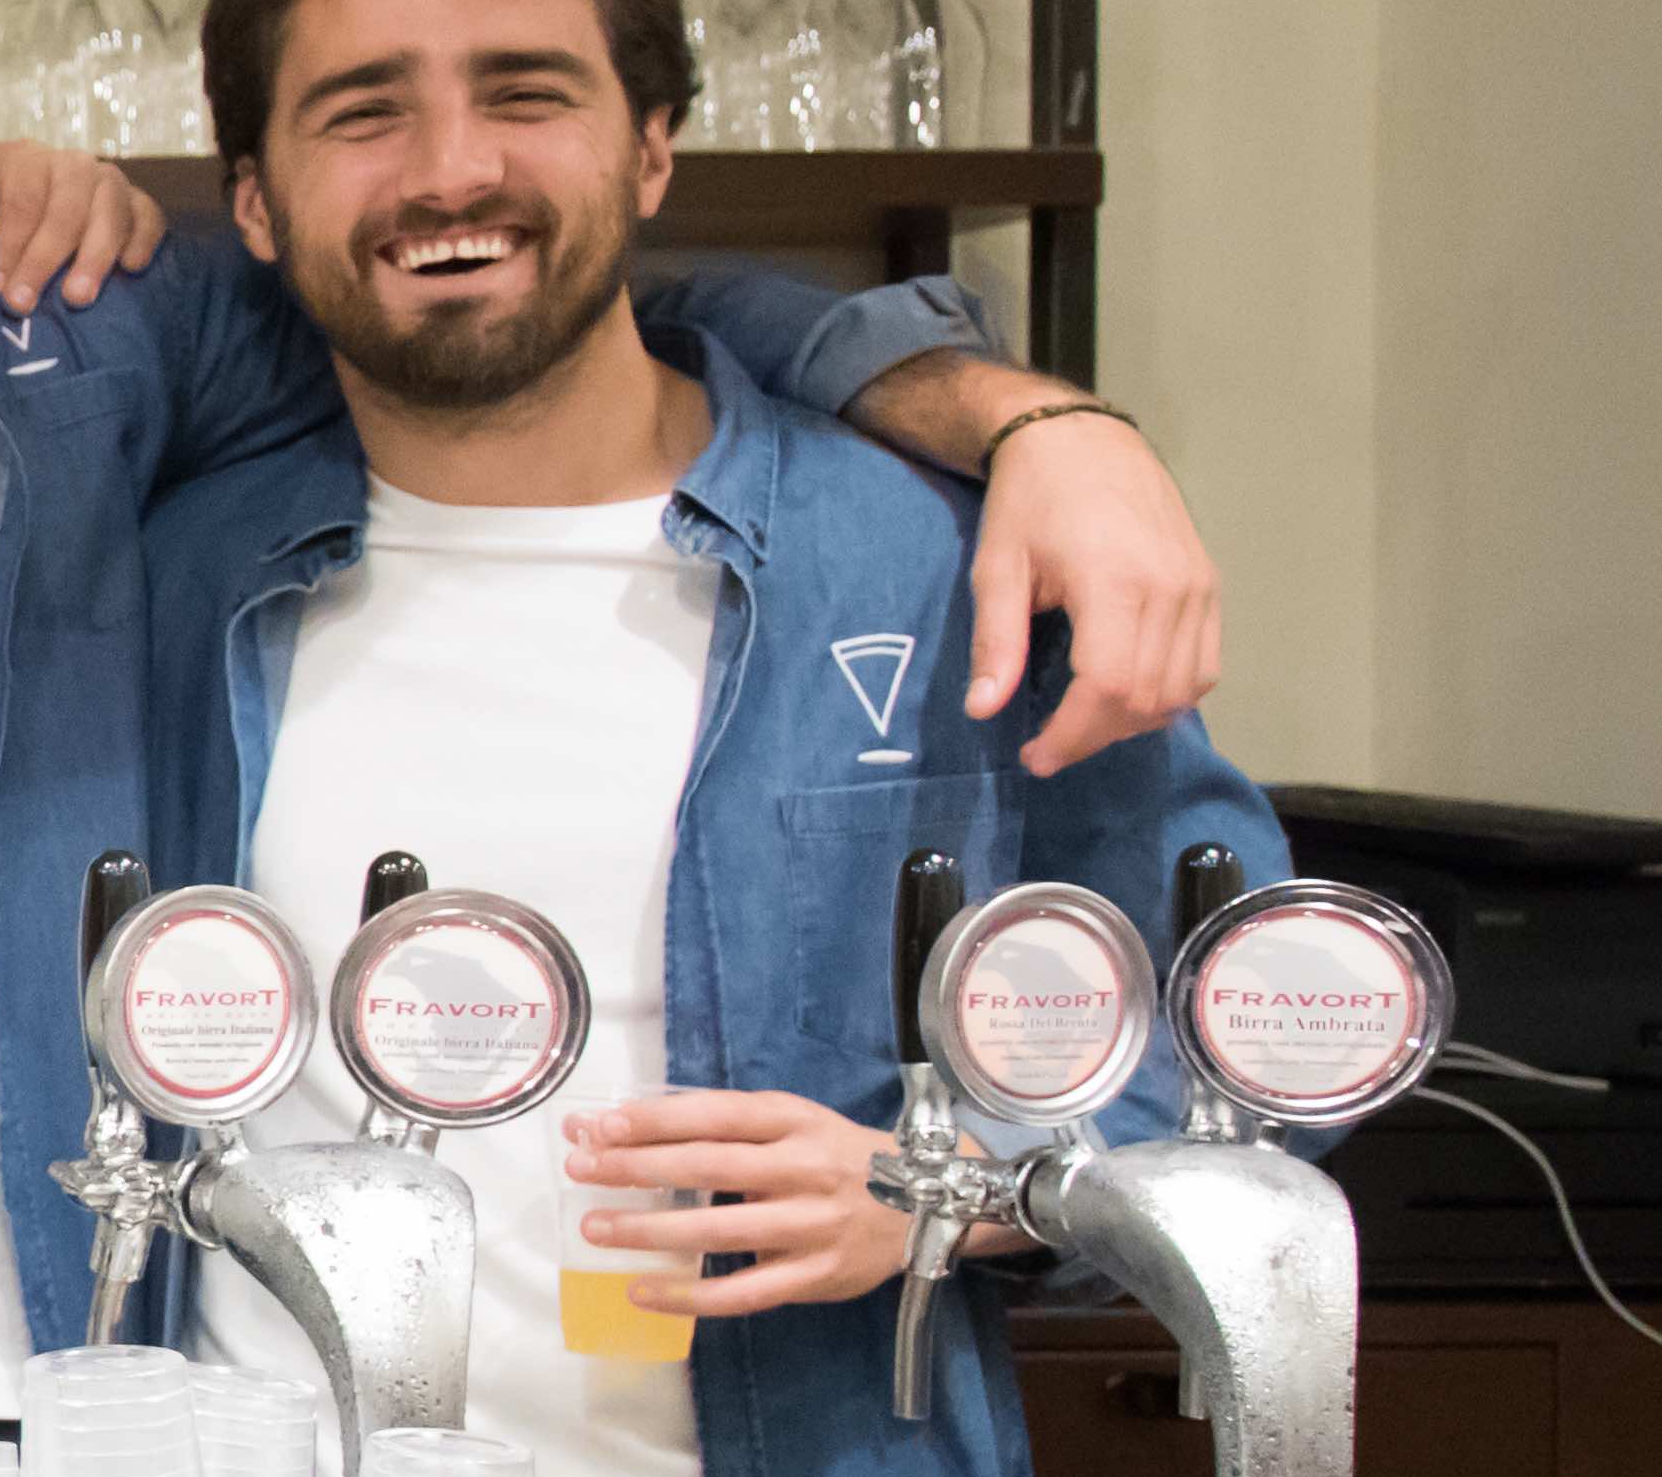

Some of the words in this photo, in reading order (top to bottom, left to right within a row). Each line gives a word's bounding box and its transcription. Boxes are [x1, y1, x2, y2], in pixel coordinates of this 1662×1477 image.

[135, 989, 280, 1007] FRAVORT
[369, 998, 546, 1018] FRAVORT
[968, 991, 1113, 1009] FRAVORT
[1213, 989, 1400, 1009] FRAVORT
[1228, 1013, 1283, 1030] Birra
[1295, 1016, 1386, 1033] Ambrata
